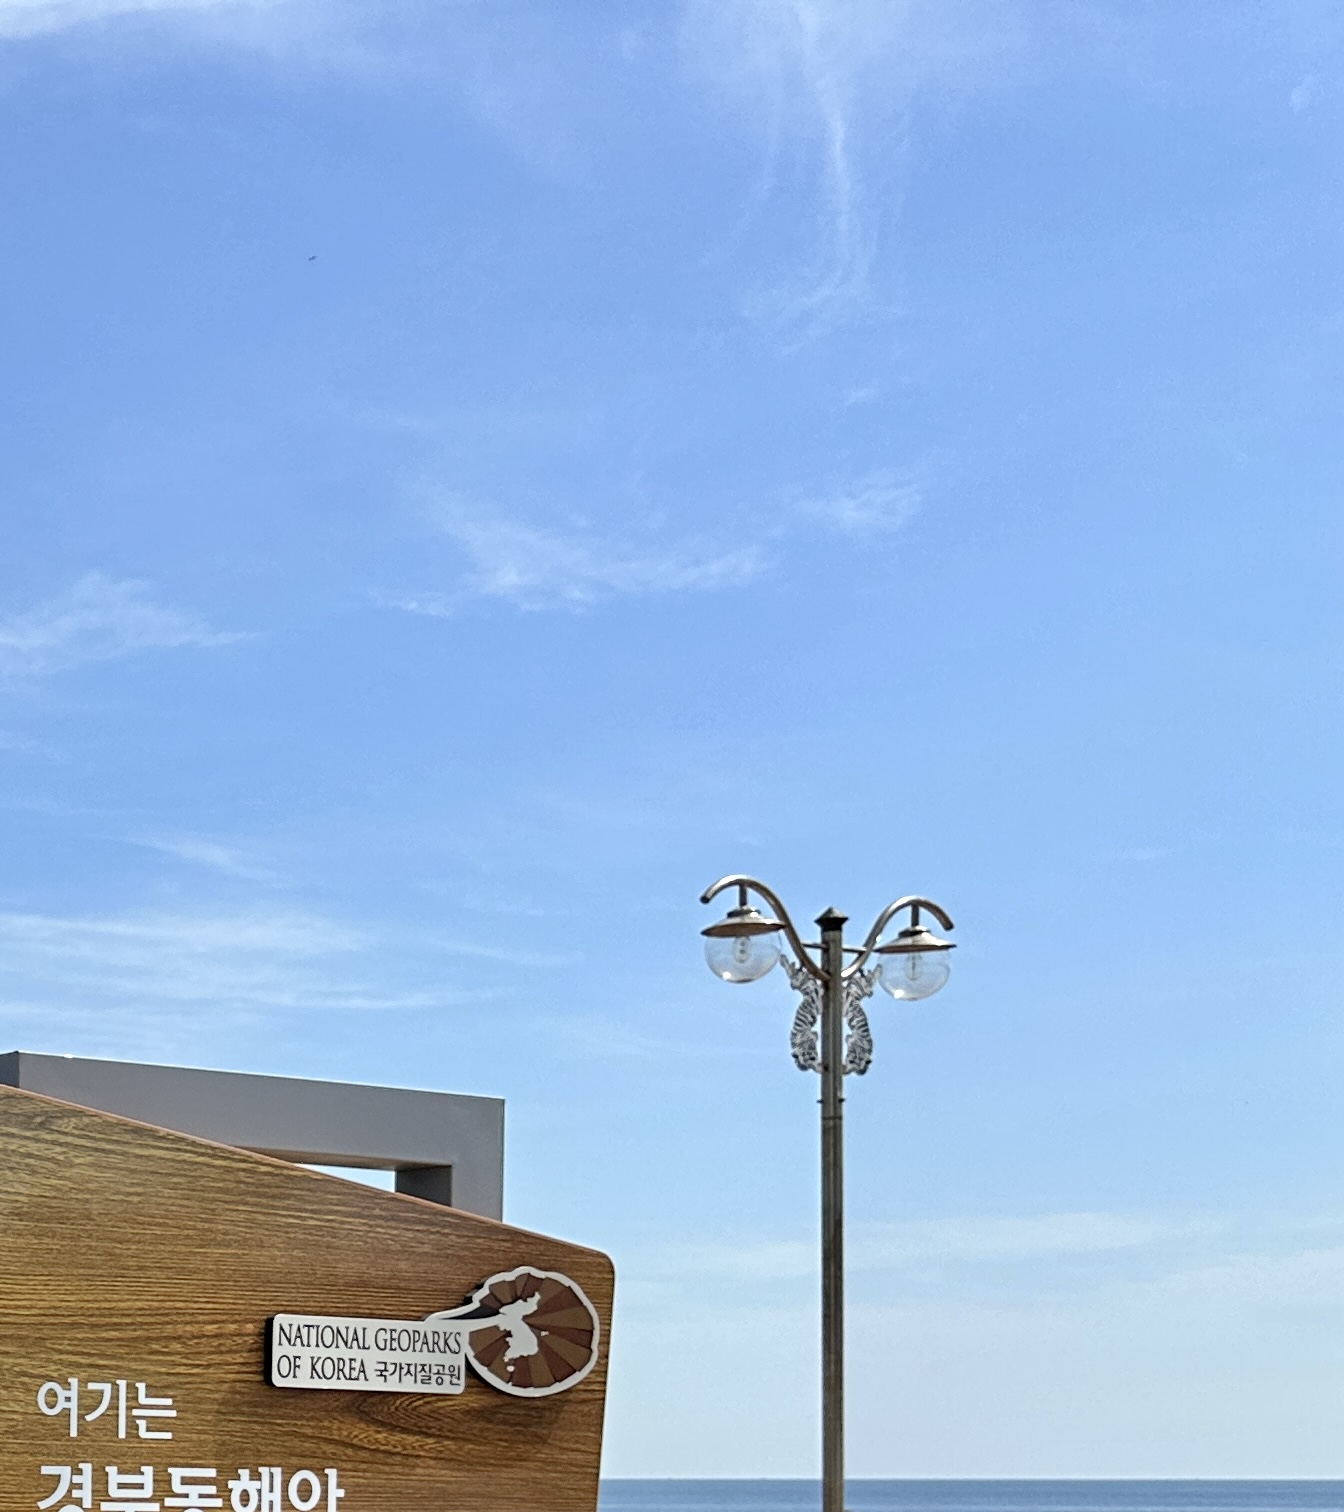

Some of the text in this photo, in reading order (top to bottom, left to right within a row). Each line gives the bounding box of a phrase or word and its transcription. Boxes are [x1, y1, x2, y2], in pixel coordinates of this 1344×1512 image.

[277, 1323, 462, 1355] NATIONAL GEOPARKS
[277, 1355, 461, 1386] OF KOREA 국가지질공원
[36, 1376, 177, 1440] 여기는
